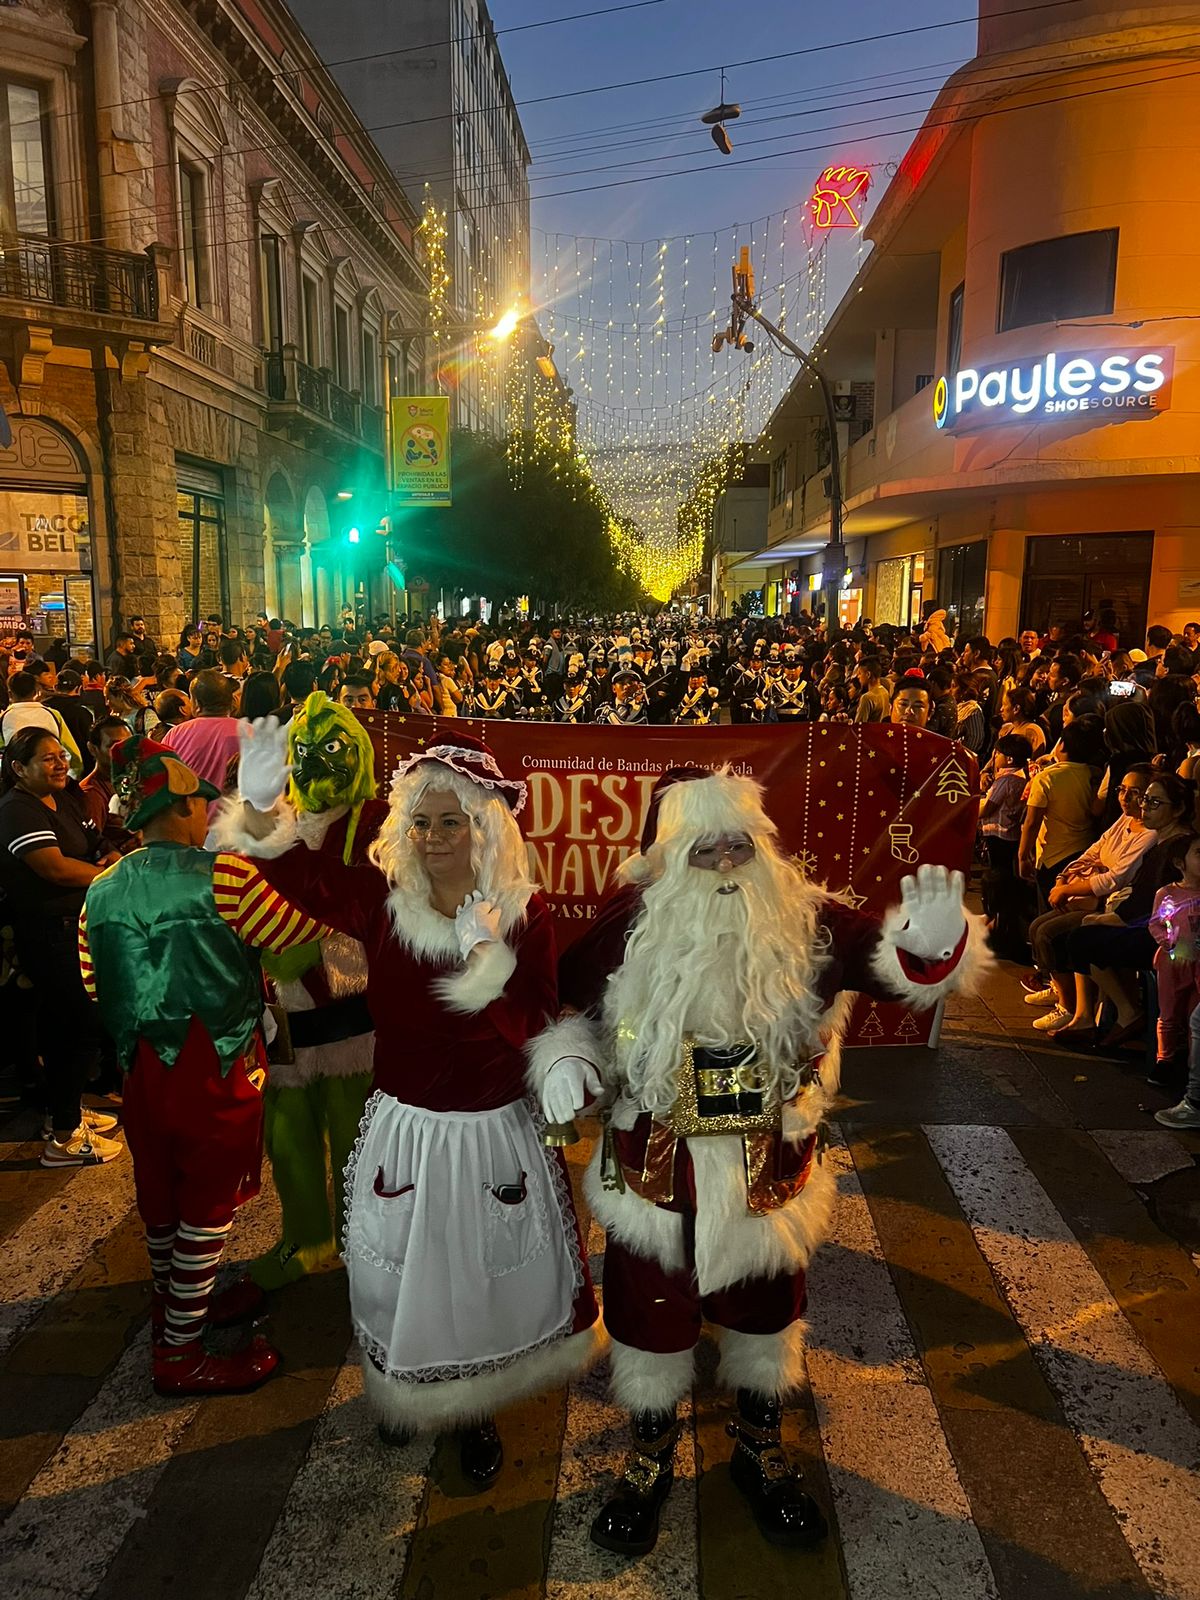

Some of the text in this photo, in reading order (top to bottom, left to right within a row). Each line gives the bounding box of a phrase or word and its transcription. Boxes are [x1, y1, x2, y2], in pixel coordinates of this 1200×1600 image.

[956, 353, 1165, 414] Payless
[20, 513, 86, 533] TACO
[522, 755, 594, 770] Comunidad
[597, 757, 613, 771] de
[617, 758, 663, 773] Bandas
[684, 760, 753, 775] Gateala
